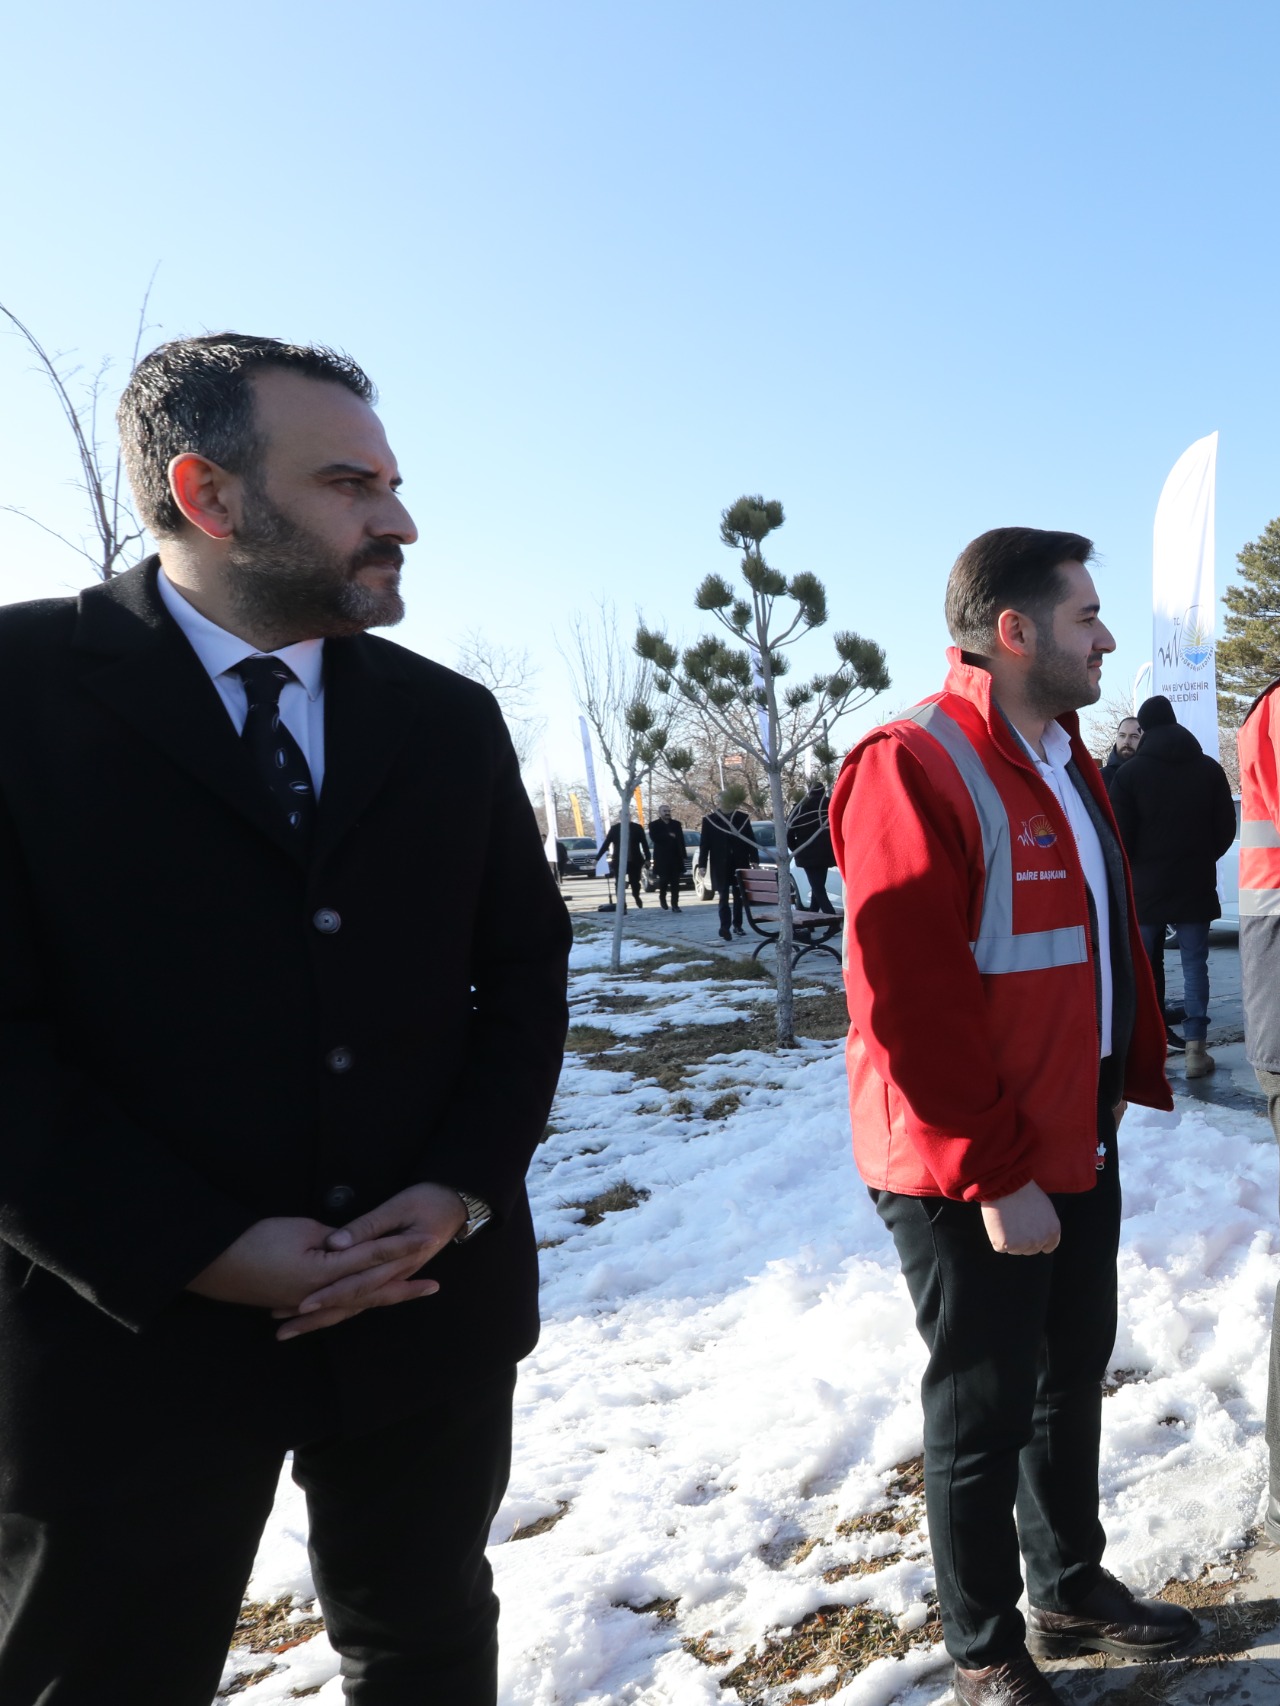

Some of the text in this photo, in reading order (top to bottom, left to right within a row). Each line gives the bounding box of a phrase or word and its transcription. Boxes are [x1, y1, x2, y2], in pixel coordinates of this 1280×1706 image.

[1162, 683, 1172, 692] VAN
[1016, 869, 1066, 882] DAİRE BAŞKANI
